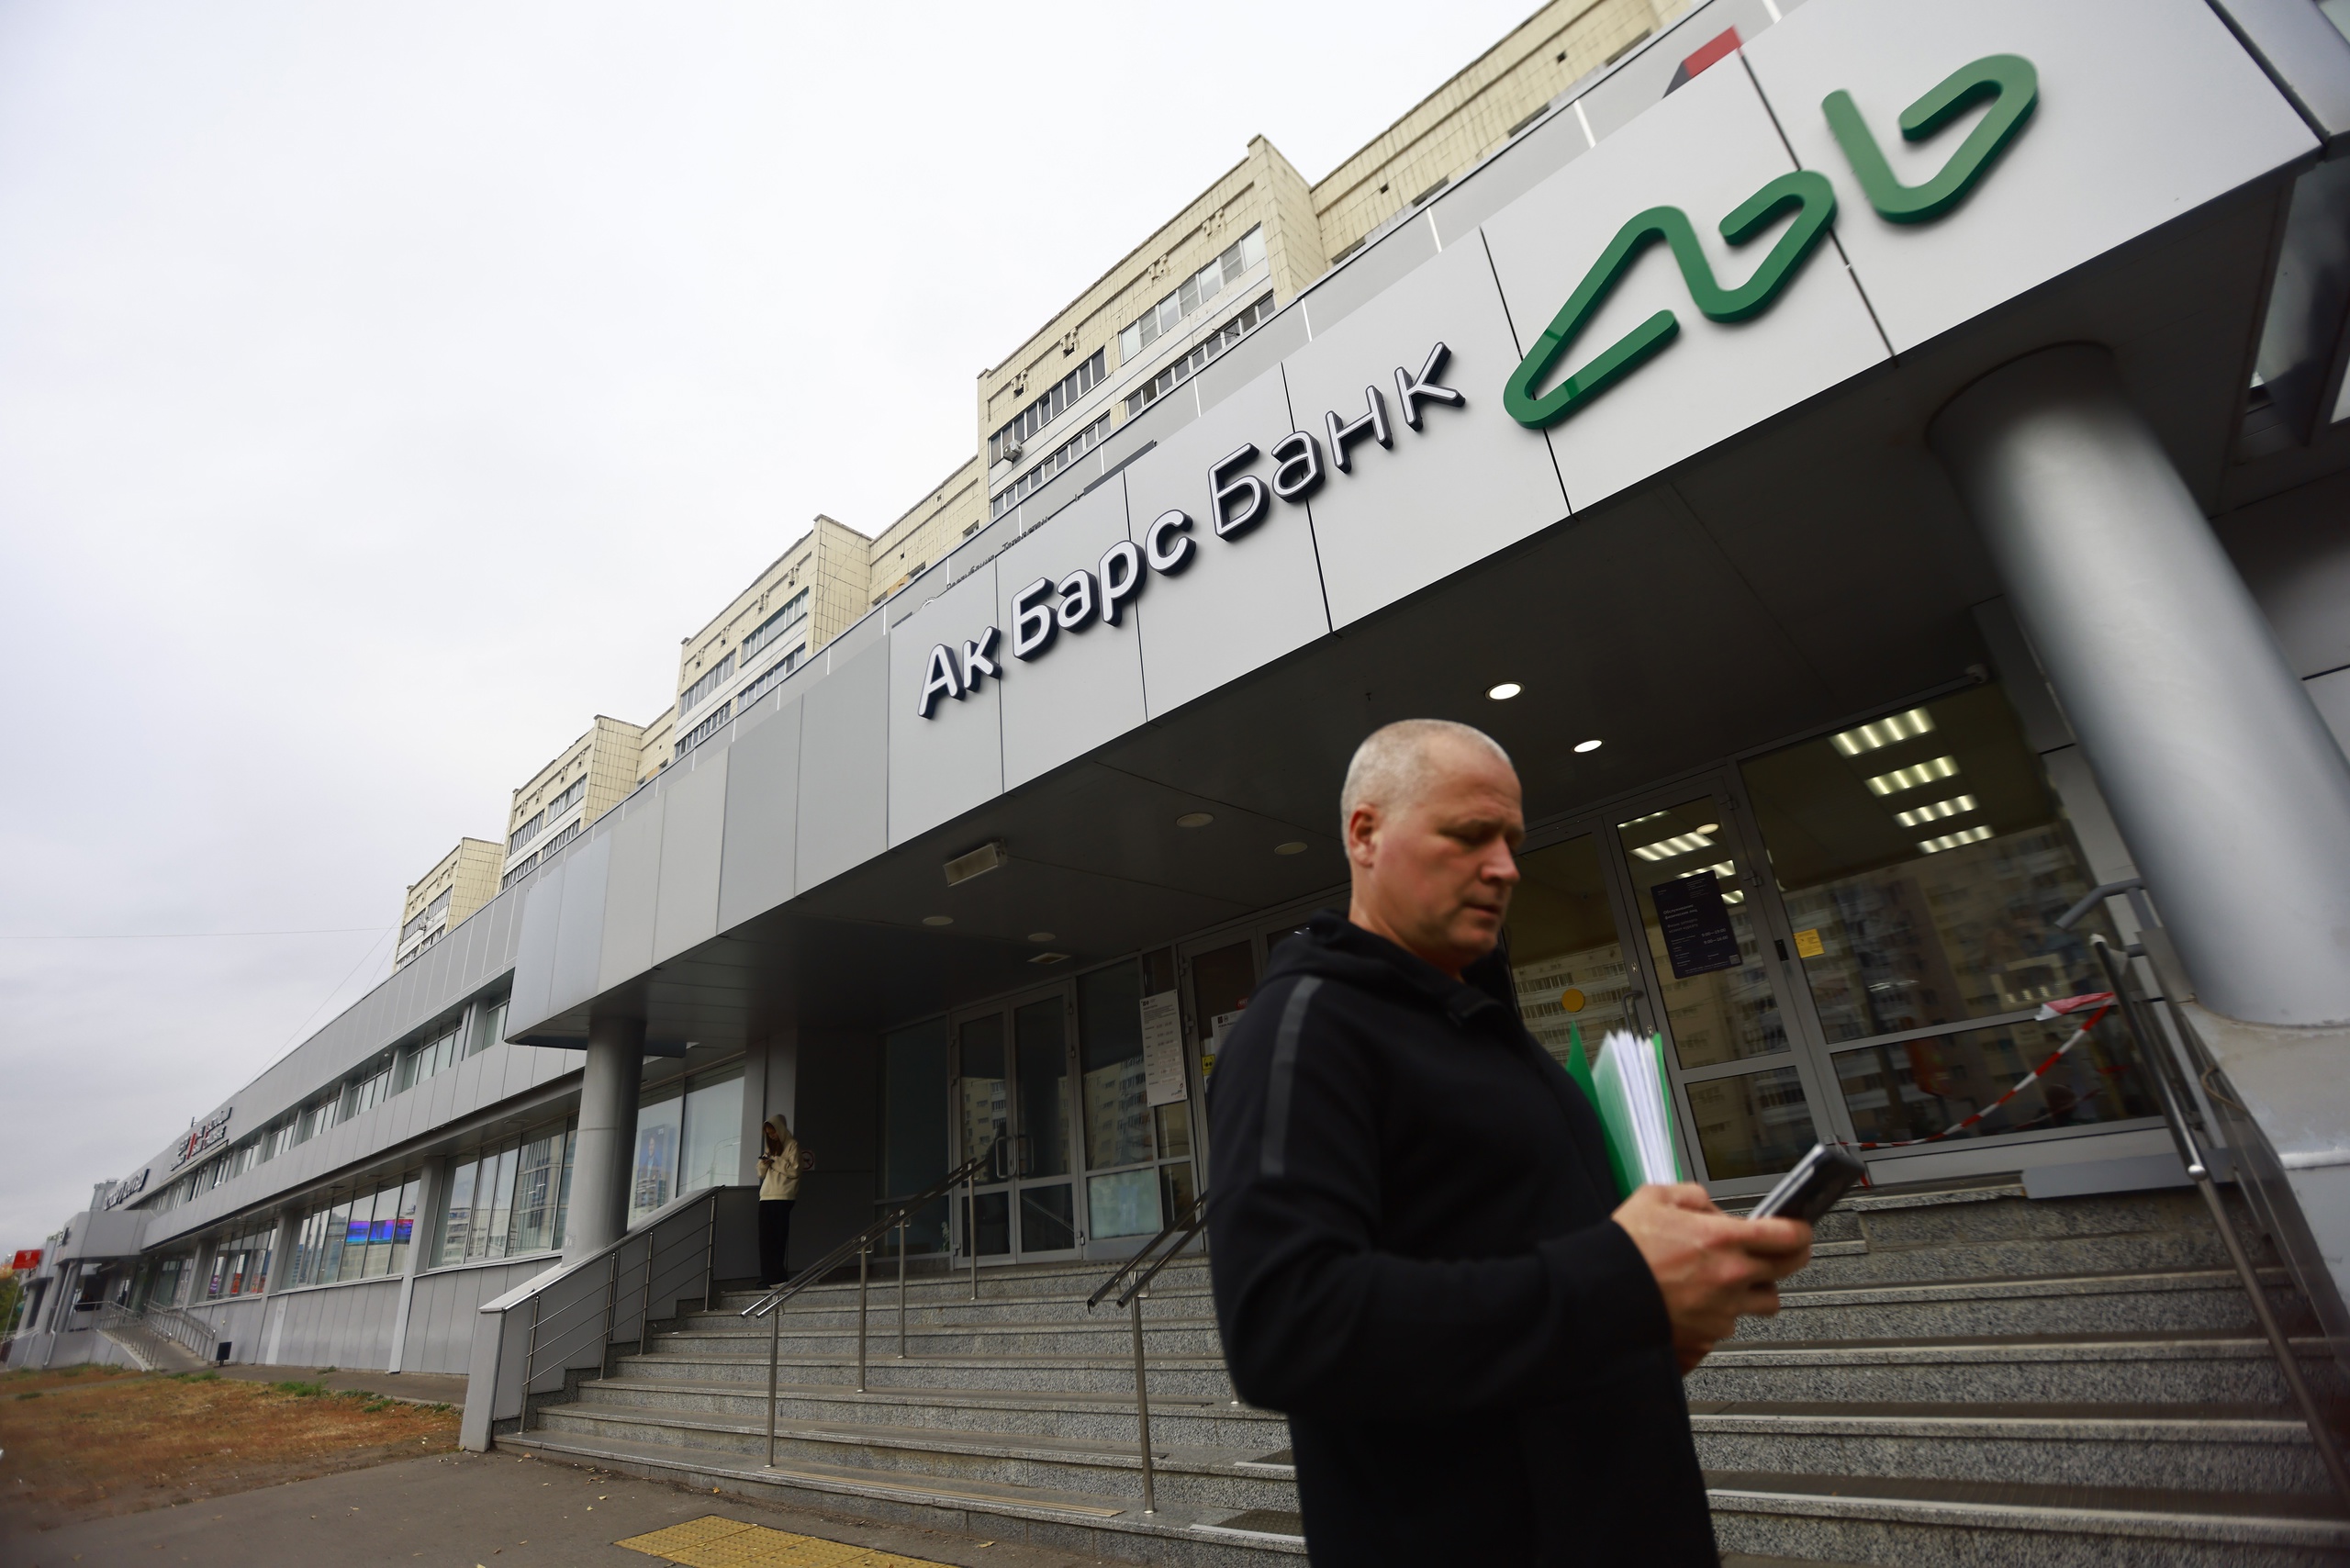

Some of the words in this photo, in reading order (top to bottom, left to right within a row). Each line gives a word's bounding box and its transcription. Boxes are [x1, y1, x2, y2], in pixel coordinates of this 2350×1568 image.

[917, 626, 1002, 719] Ак
[1011, 509, 1196, 662] Барс
[1207, 342, 1466, 542] Банк
